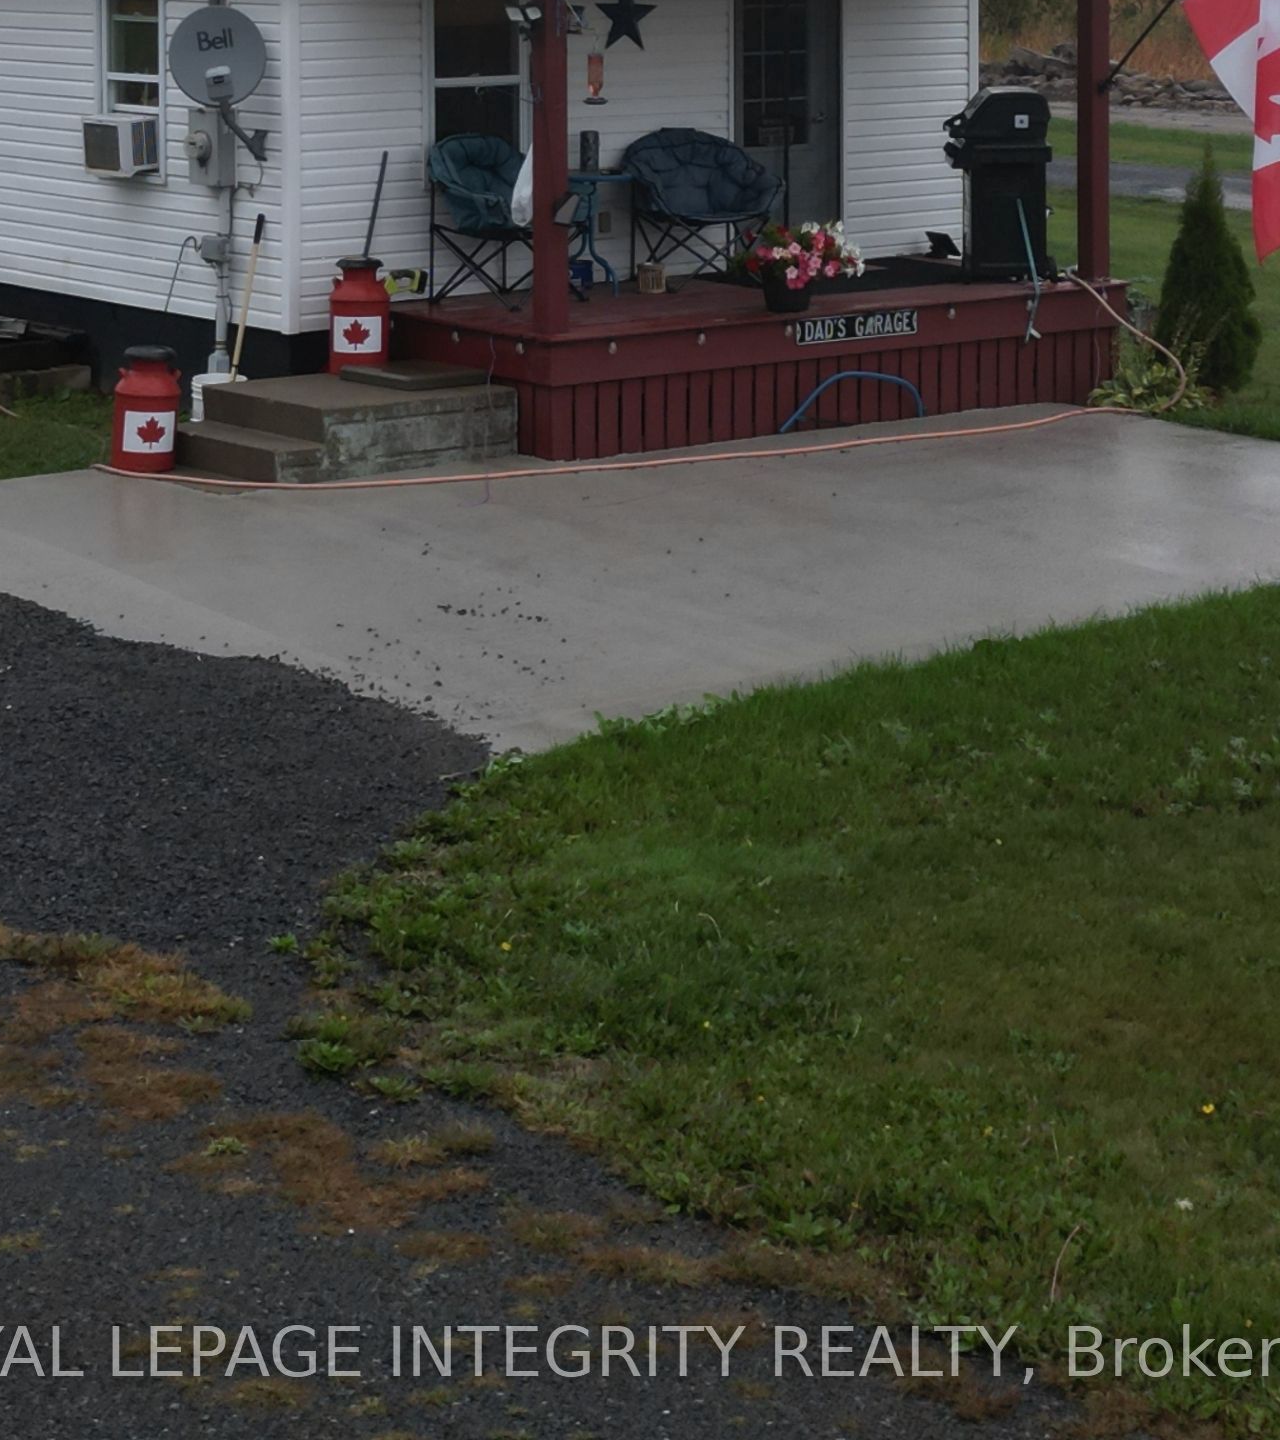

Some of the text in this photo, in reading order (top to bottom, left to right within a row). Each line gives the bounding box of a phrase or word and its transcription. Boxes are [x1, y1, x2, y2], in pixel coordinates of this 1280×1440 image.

[197, 27, 234, 51] Bell
[804, 311, 911, 342] DAD'S GARAGE
